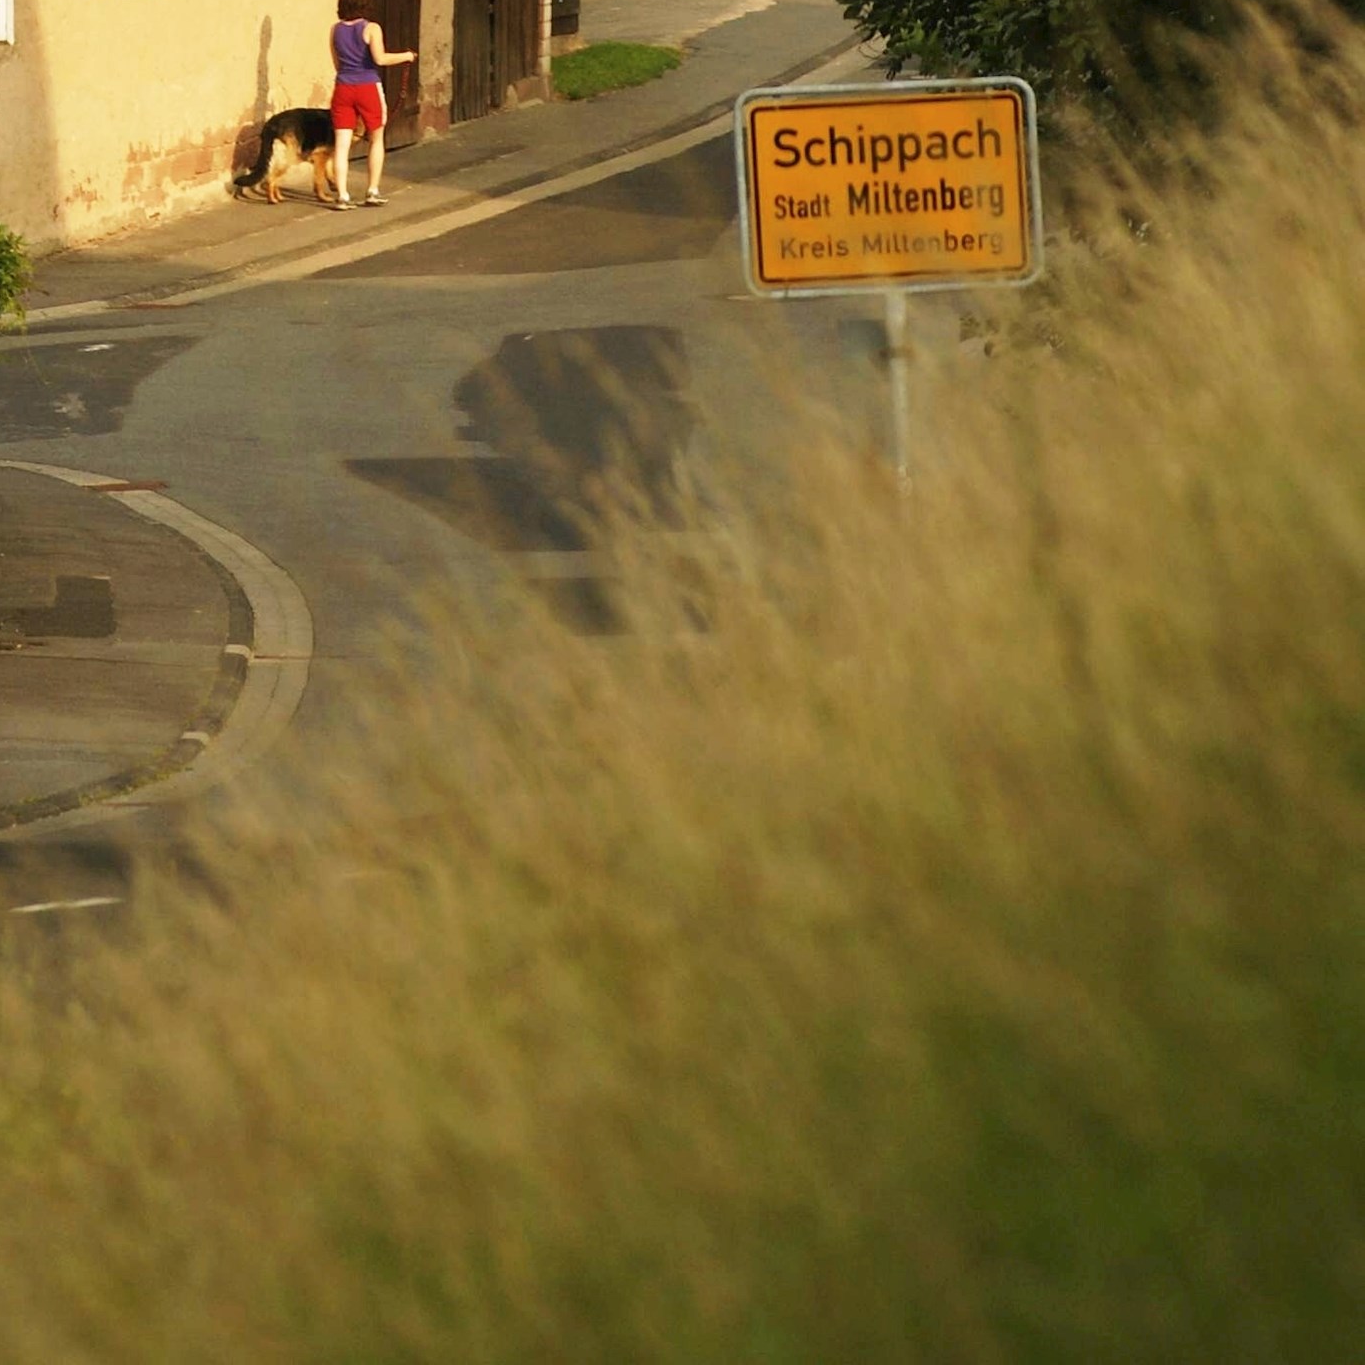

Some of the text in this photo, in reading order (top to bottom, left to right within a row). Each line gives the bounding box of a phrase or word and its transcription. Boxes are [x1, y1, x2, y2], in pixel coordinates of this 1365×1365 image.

[773, 119, 1002, 173] Schippach
[774, 177, 1004, 220] Stadt Miltenberg
[780, 229, 1004, 260] Kreis Miltenberg
